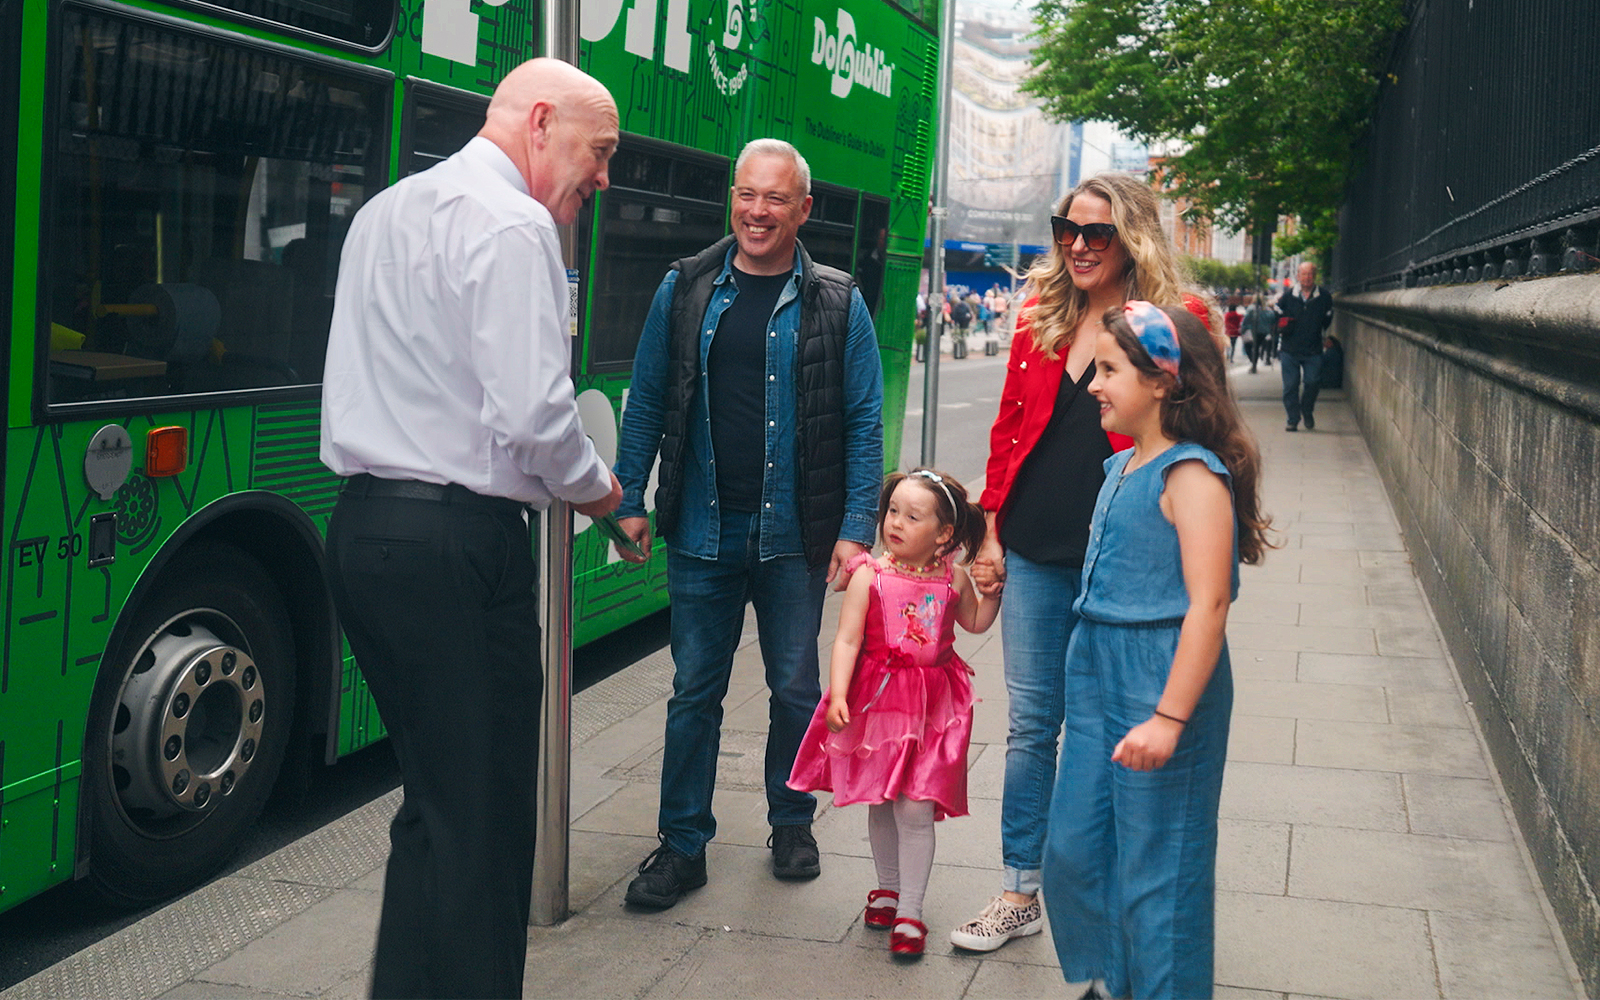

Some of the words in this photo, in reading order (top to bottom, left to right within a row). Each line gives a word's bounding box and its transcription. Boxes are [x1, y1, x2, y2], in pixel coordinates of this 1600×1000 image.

[708, 40, 728, 95] SINCE
[729, 63, 747, 96] 1988
[805, 116, 816, 136] The
[817, 121, 846, 146] Dubliner's
[847, 132, 862, 151] Guide
[869, 140, 886, 159] Dublin
[19, 541, 48, 567] EV
[57, 533, 82, 560] 50
